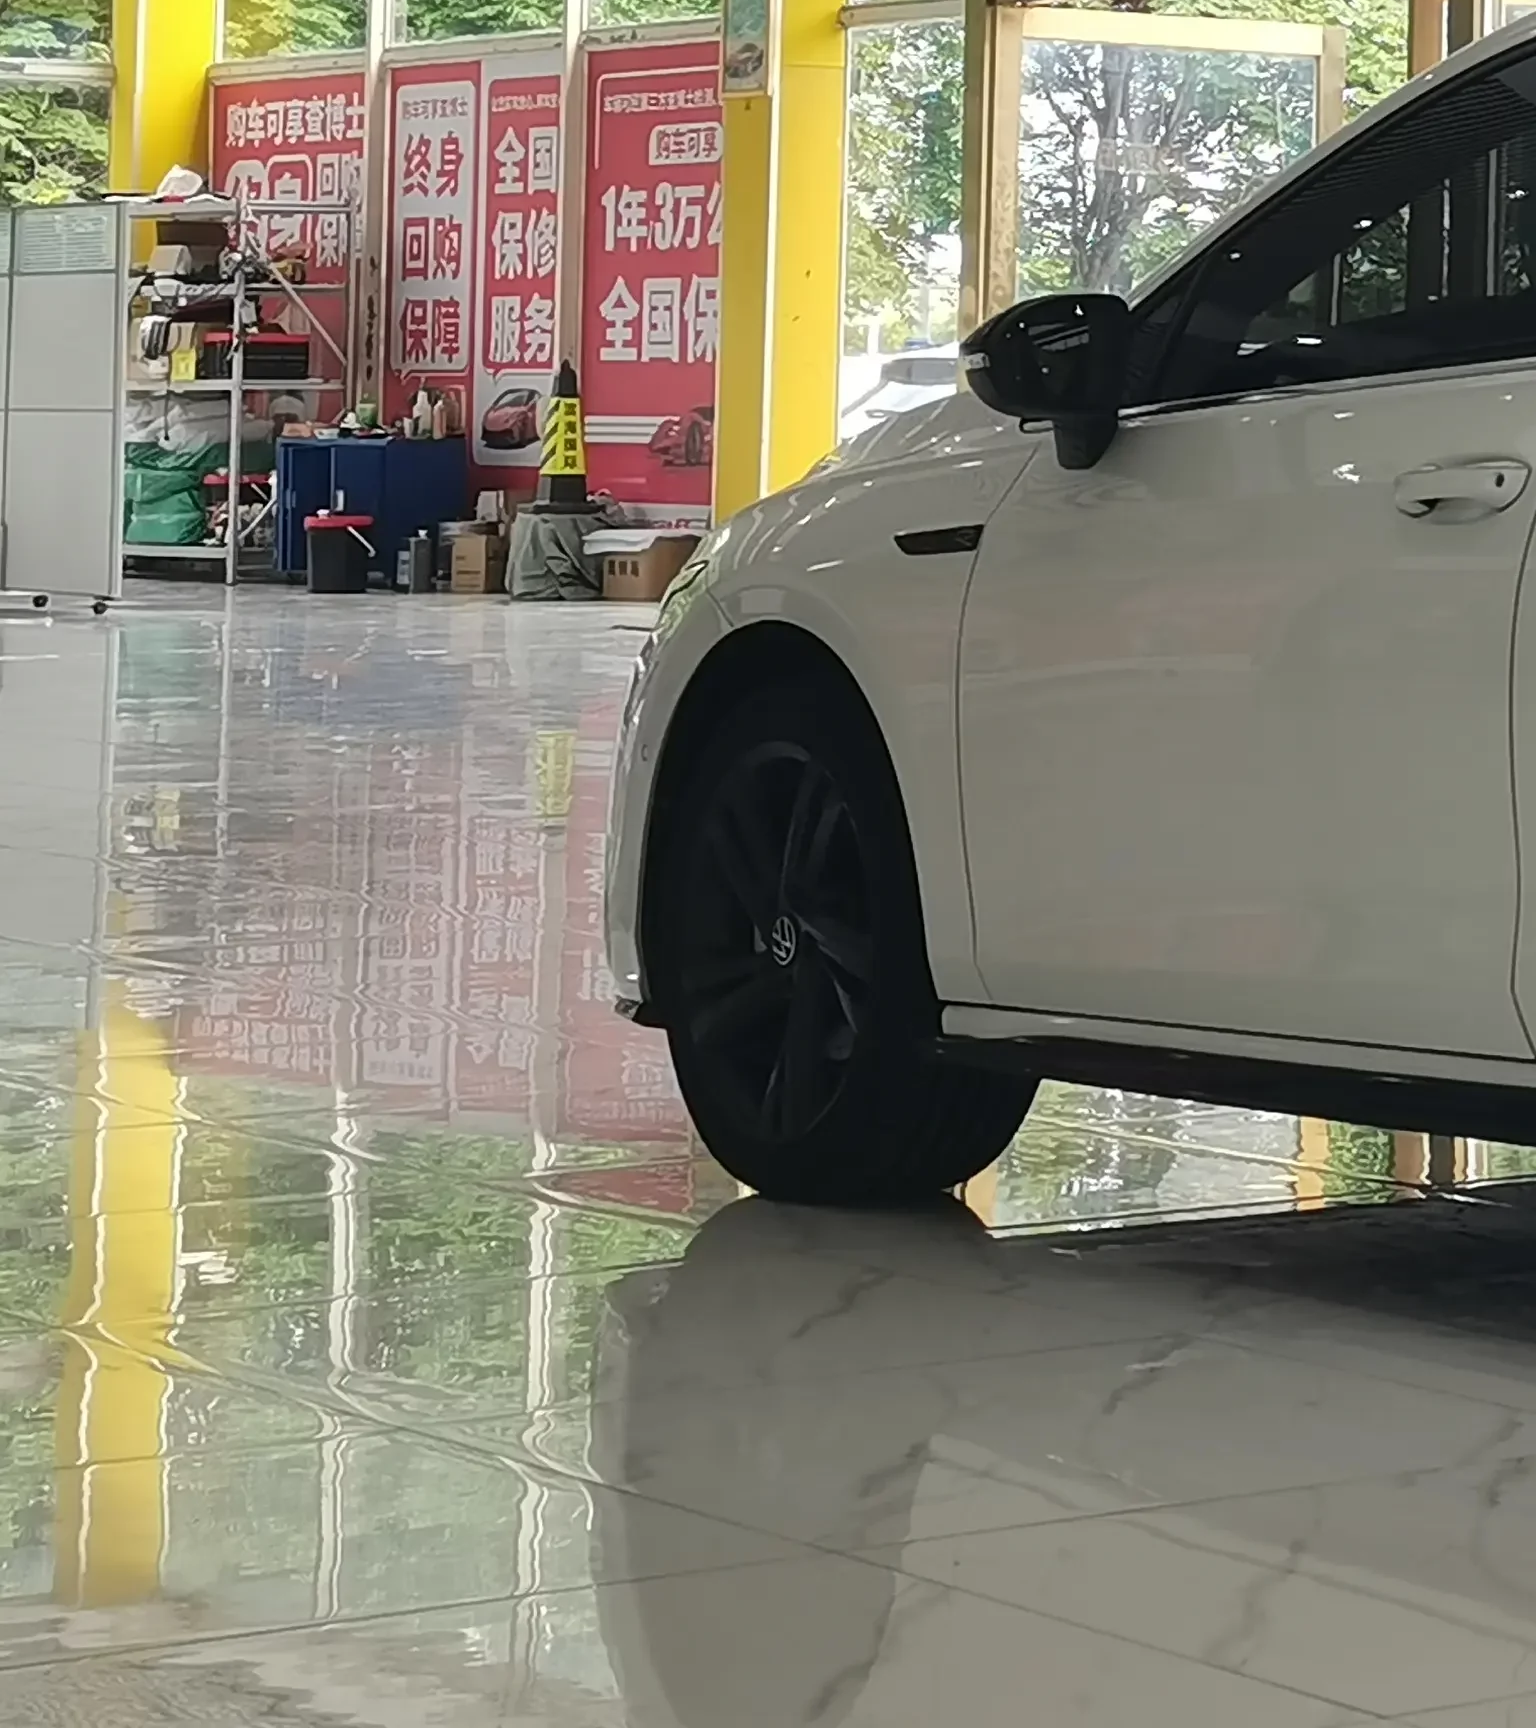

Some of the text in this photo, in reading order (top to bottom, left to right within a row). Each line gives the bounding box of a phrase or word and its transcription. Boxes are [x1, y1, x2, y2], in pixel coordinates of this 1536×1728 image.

[225, 92, 365, 148] 购车可享查博士
[402, 130, 464, 198] 终身
[494, 126, 558, 195] 全国
[402, 214, 462, 281] 回购
[492, 207, 557, 280] 保修
[400, 296, 461, 364] 保障
[489, 293, 555, 364] 服务
[599, 274, 719, 362] 全国保
